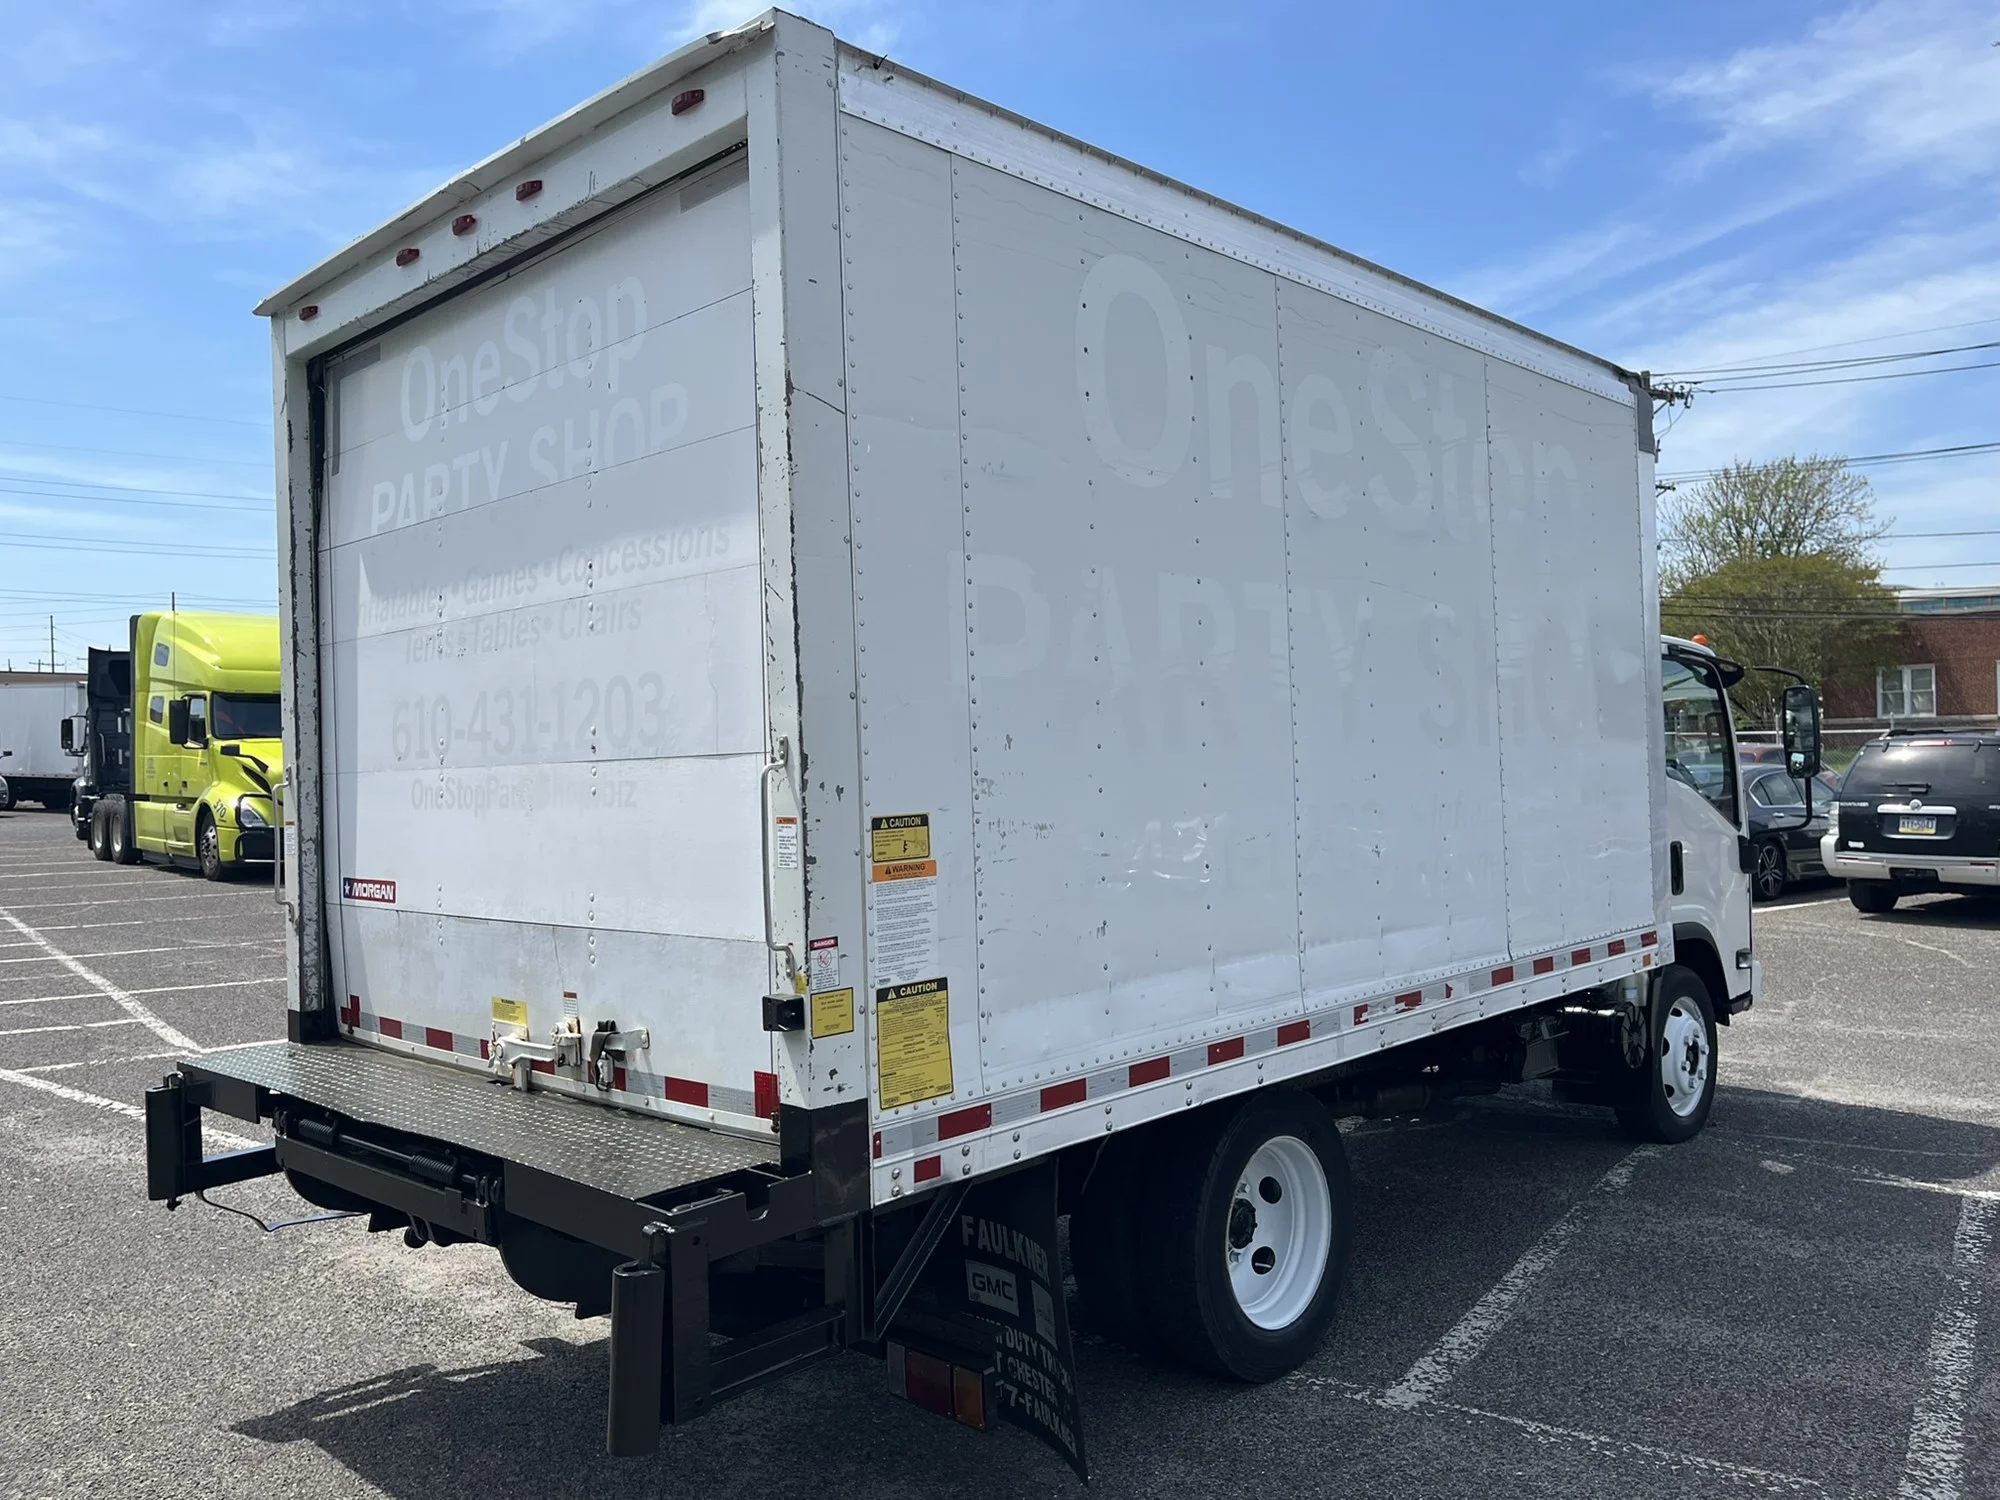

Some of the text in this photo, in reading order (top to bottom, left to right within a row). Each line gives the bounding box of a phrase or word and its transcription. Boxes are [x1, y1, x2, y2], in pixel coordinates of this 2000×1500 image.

[401, 276, 648, 442] OneStop
[370, 383, 689, 537] PARTY SHOP
[464, 562, 538, 605] Games
[556, 520, 730, 586] Concessions
[466, 612, 541, 655] Tables
[559, 596, 642, 641] Chairs
[392, 671, 666, 762] 610-431-1203
[213, 799, 227, 818] 370
[889, 816, 922, 828] CAUTION
[892, 862, 926, 874] WARNING
[352, 882, 394, 900] MORGAN
[813, 939, 835, 948] DANGER
[900, 981, 938, 996] CAUTION
[961, 1214, 1052, 1286] FAULKNER
[972, 1272, 1015, 1301] GMC
[1005, 1327, 1038, 1361] DUTY
